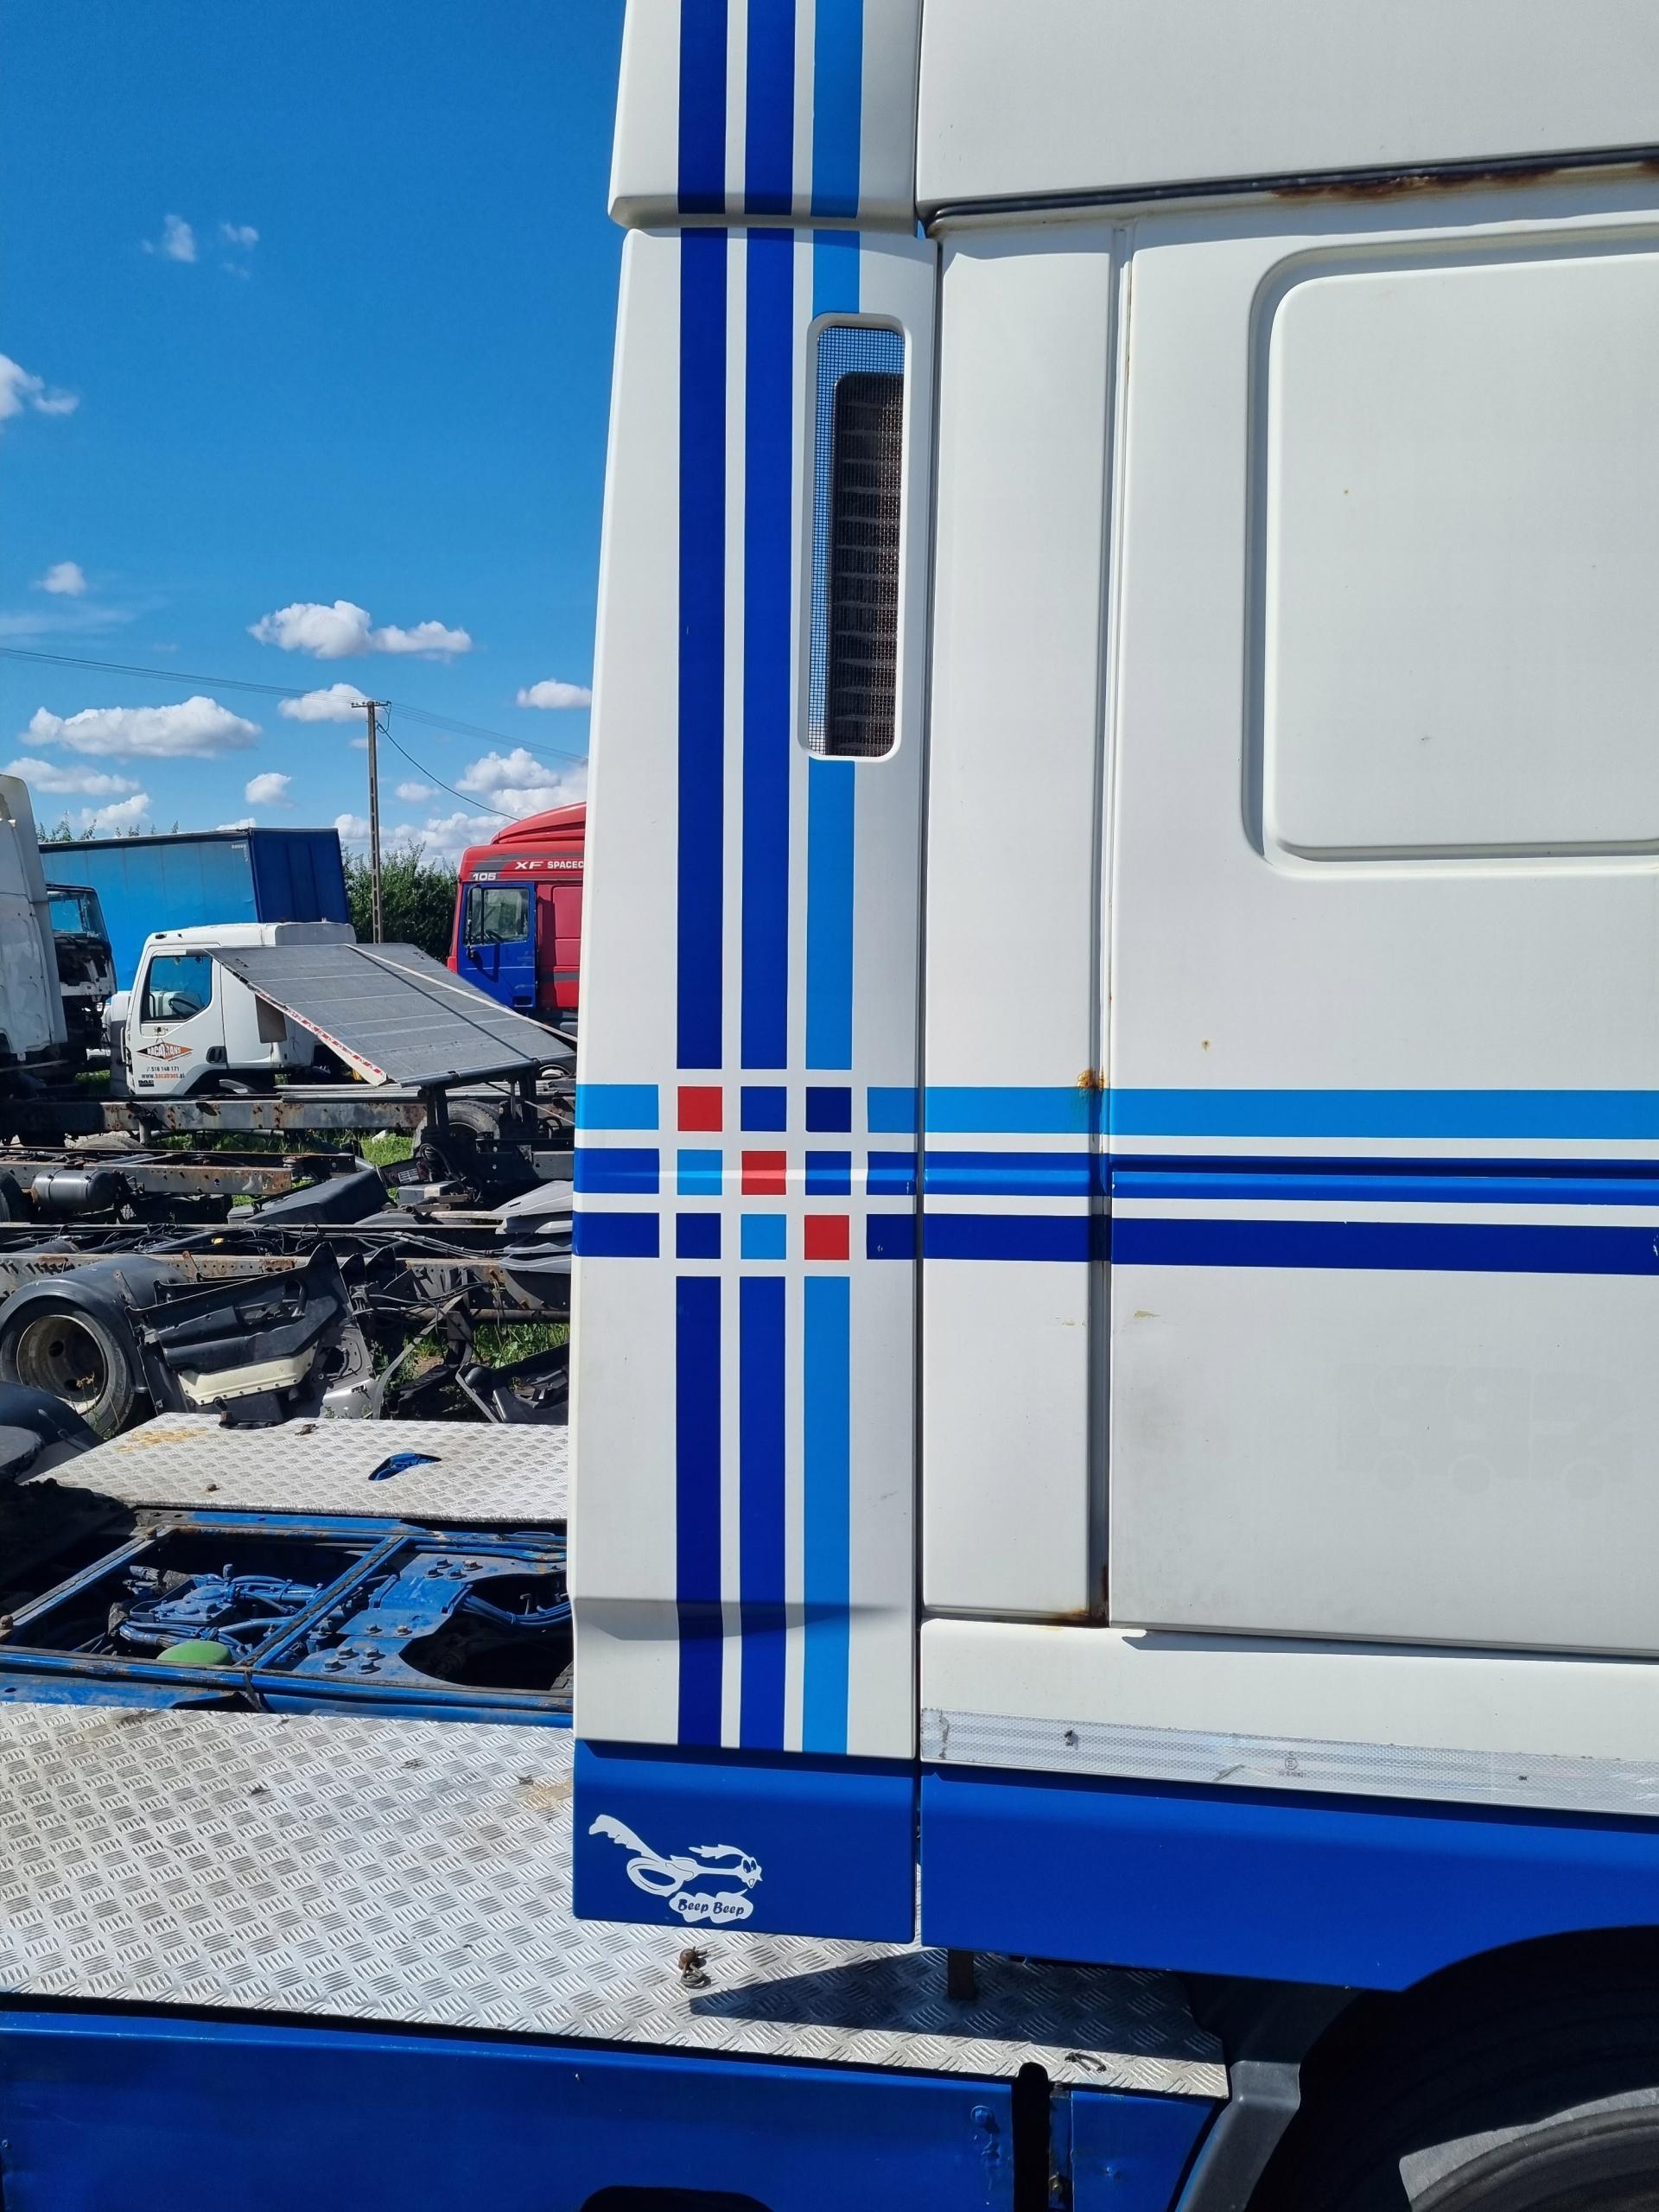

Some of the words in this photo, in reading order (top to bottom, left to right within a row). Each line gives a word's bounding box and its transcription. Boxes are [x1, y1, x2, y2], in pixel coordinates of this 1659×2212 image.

[515, 861, 543, 869] XF
[473, 872, 497, 880] 105
[677, 1899, 709, 1914] Beep
[713, 1902, 745, 1916] Beep
